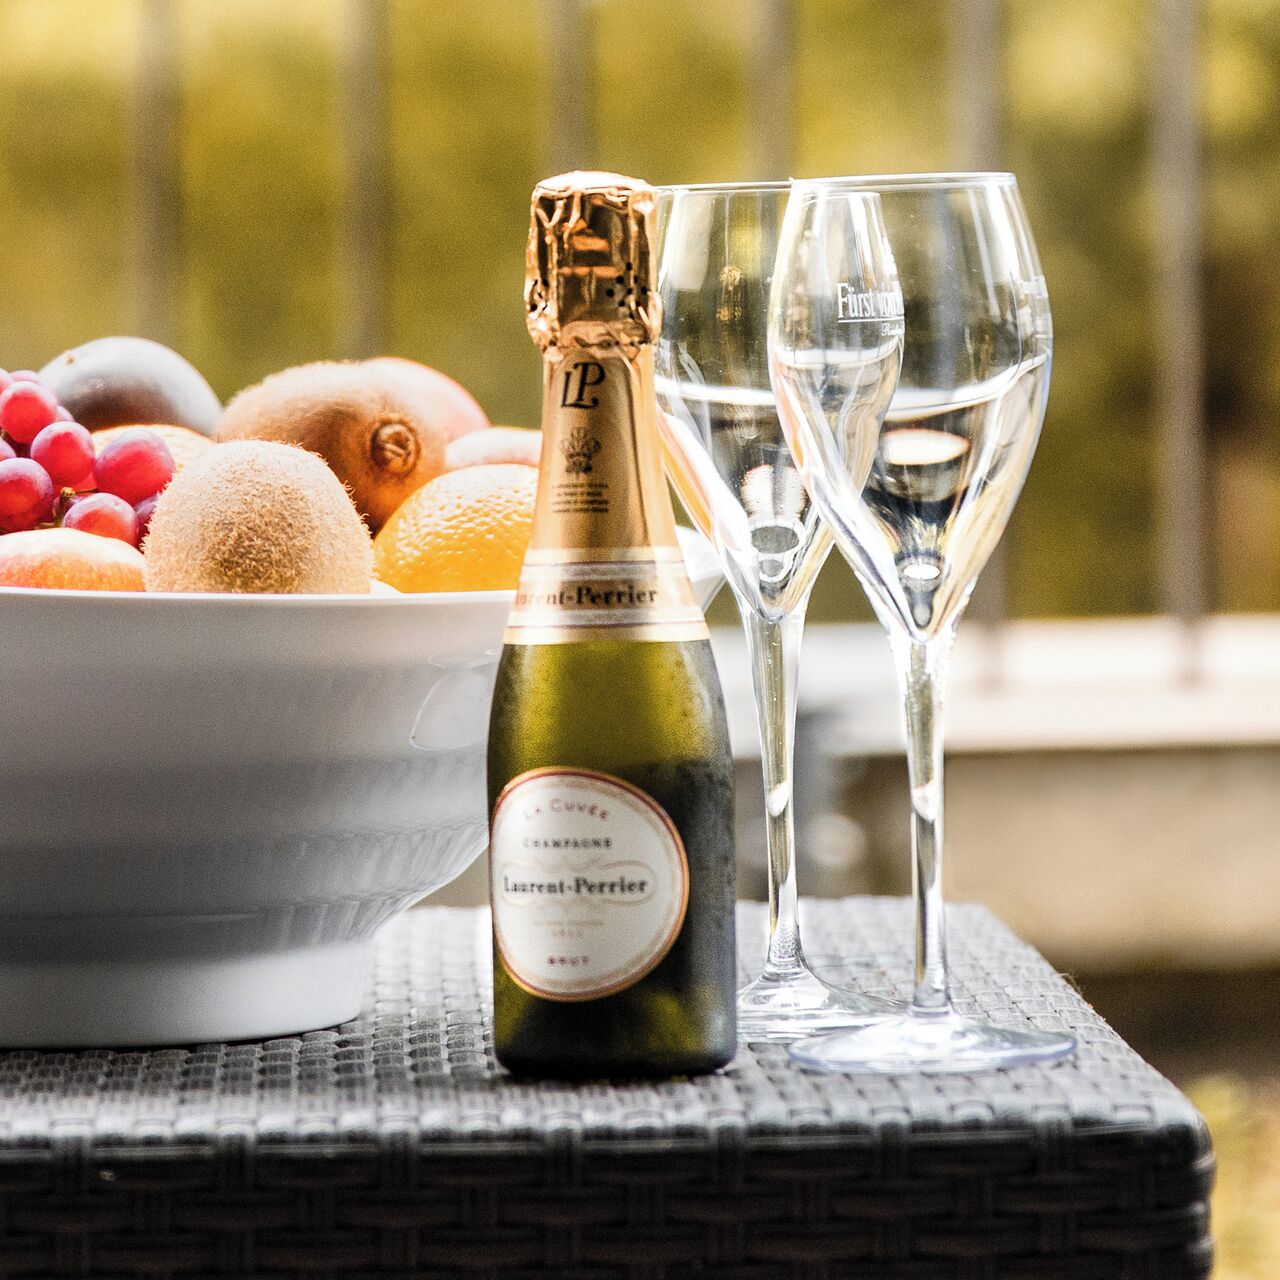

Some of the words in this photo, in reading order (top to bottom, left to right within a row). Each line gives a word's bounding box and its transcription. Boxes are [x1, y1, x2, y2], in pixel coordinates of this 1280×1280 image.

[837, 282, 876, 318] Fürst
[561, 361, 606, 408] LP
[523, 837, 612, 849] CHAMPAGNE
[503, 875, 648, 894] Laurent-Perrier
[546, 955, 589, 967] BRUT
